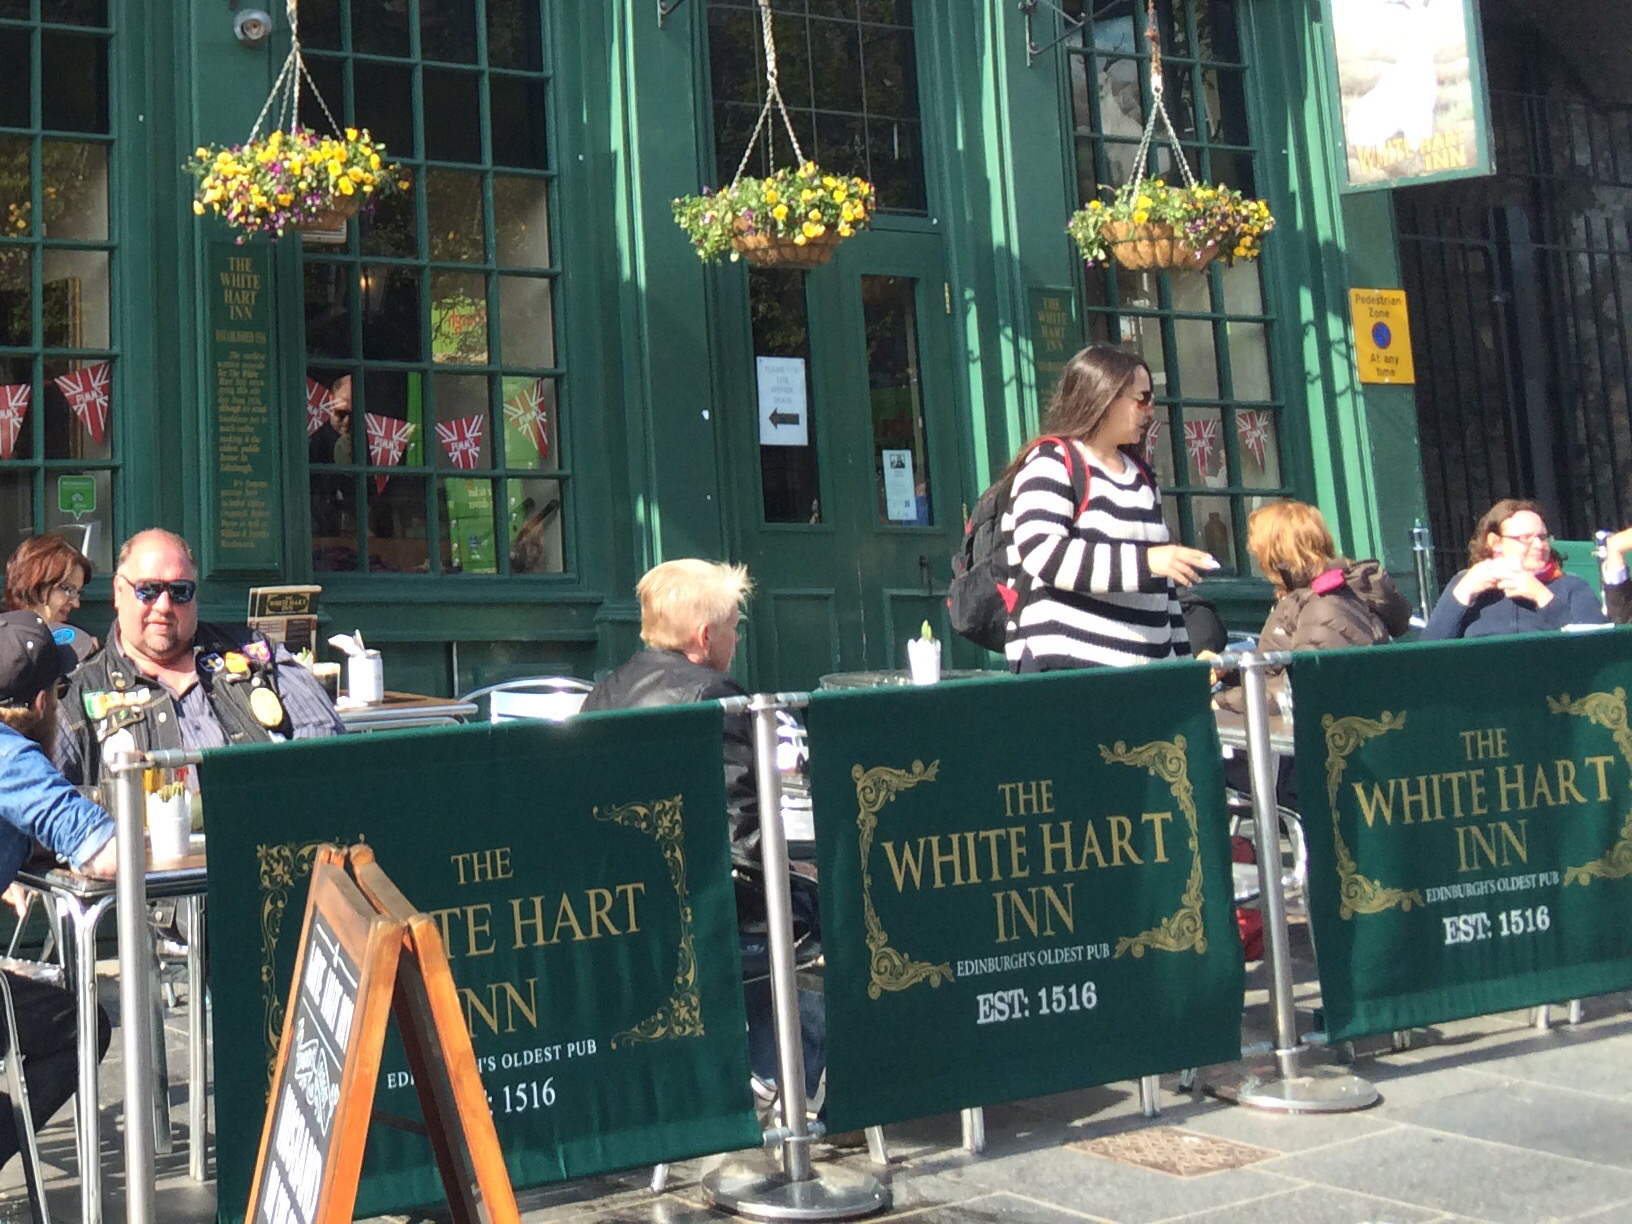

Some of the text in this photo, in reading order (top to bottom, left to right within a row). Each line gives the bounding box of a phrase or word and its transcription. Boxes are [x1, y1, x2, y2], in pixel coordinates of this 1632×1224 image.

[1424, 144, 1467, 171] INN
[220, 272, 261, 290] WHITE
[228, 256, 253, 272] THE
[224, 288, 257, 305] HART
[229, 305, 254, 321] INN
[1354, 293, 1402, 306] Pedestrian
[1368, 307, 1390, 318] Zone
[1370, 353, 1399, 366] At any
[1376, 366, 1396, 377] time
[1459, 728, 1510, 762] THE
[998, 779, 1055, 818] THE
[1351, 755, 1615, 828] WHITE HART
[881, 811, 1173, 894] WHITE HART
[1455, 819, 1529, 873] INN
[450, 846, 514, 886] THE
[1425, 871, 1560, 904] EDINBURGH'S OLDEST PUB
[508, 882, 647, 950] HART
[992, 883, 1076, 944] INN
[1442, 905, 1551, 946] EST: 1516
[956, 942, 1111, 977] EDINBURGH'S OLDEST PUB
[466, 976, 542, 1040] NN
[975, 981, 1098, 1025] EST: 1516
[501, 1044, 562, 1073] OLDEST
[567, 1038, 598, 1059] PUB
[503, 1076, 557, 1115] 1516
